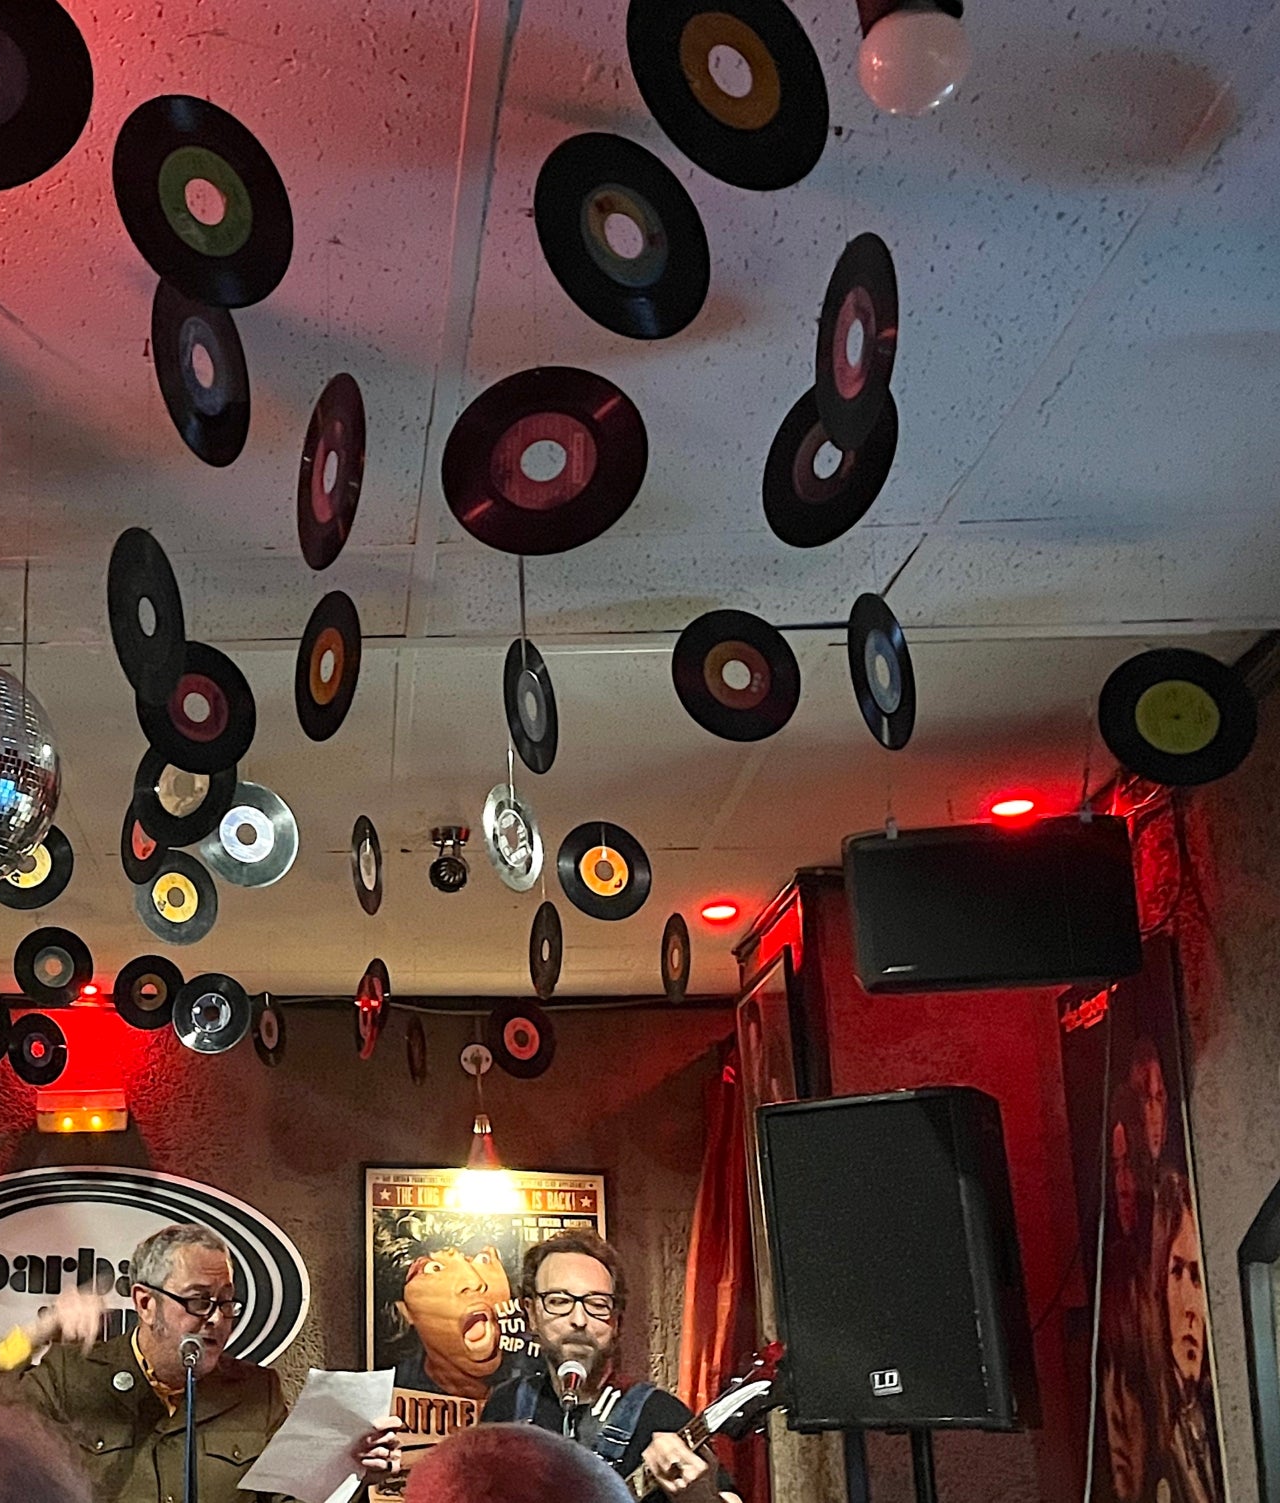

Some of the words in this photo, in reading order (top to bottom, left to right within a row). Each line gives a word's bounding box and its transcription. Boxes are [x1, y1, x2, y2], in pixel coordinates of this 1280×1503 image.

[396, 1186, 414, 1205] THE
[547, 1191, 576, 1211] BACK!
[499, 1335, 525, 1353] RIP
[527, 1341, 541, 1358] IT
